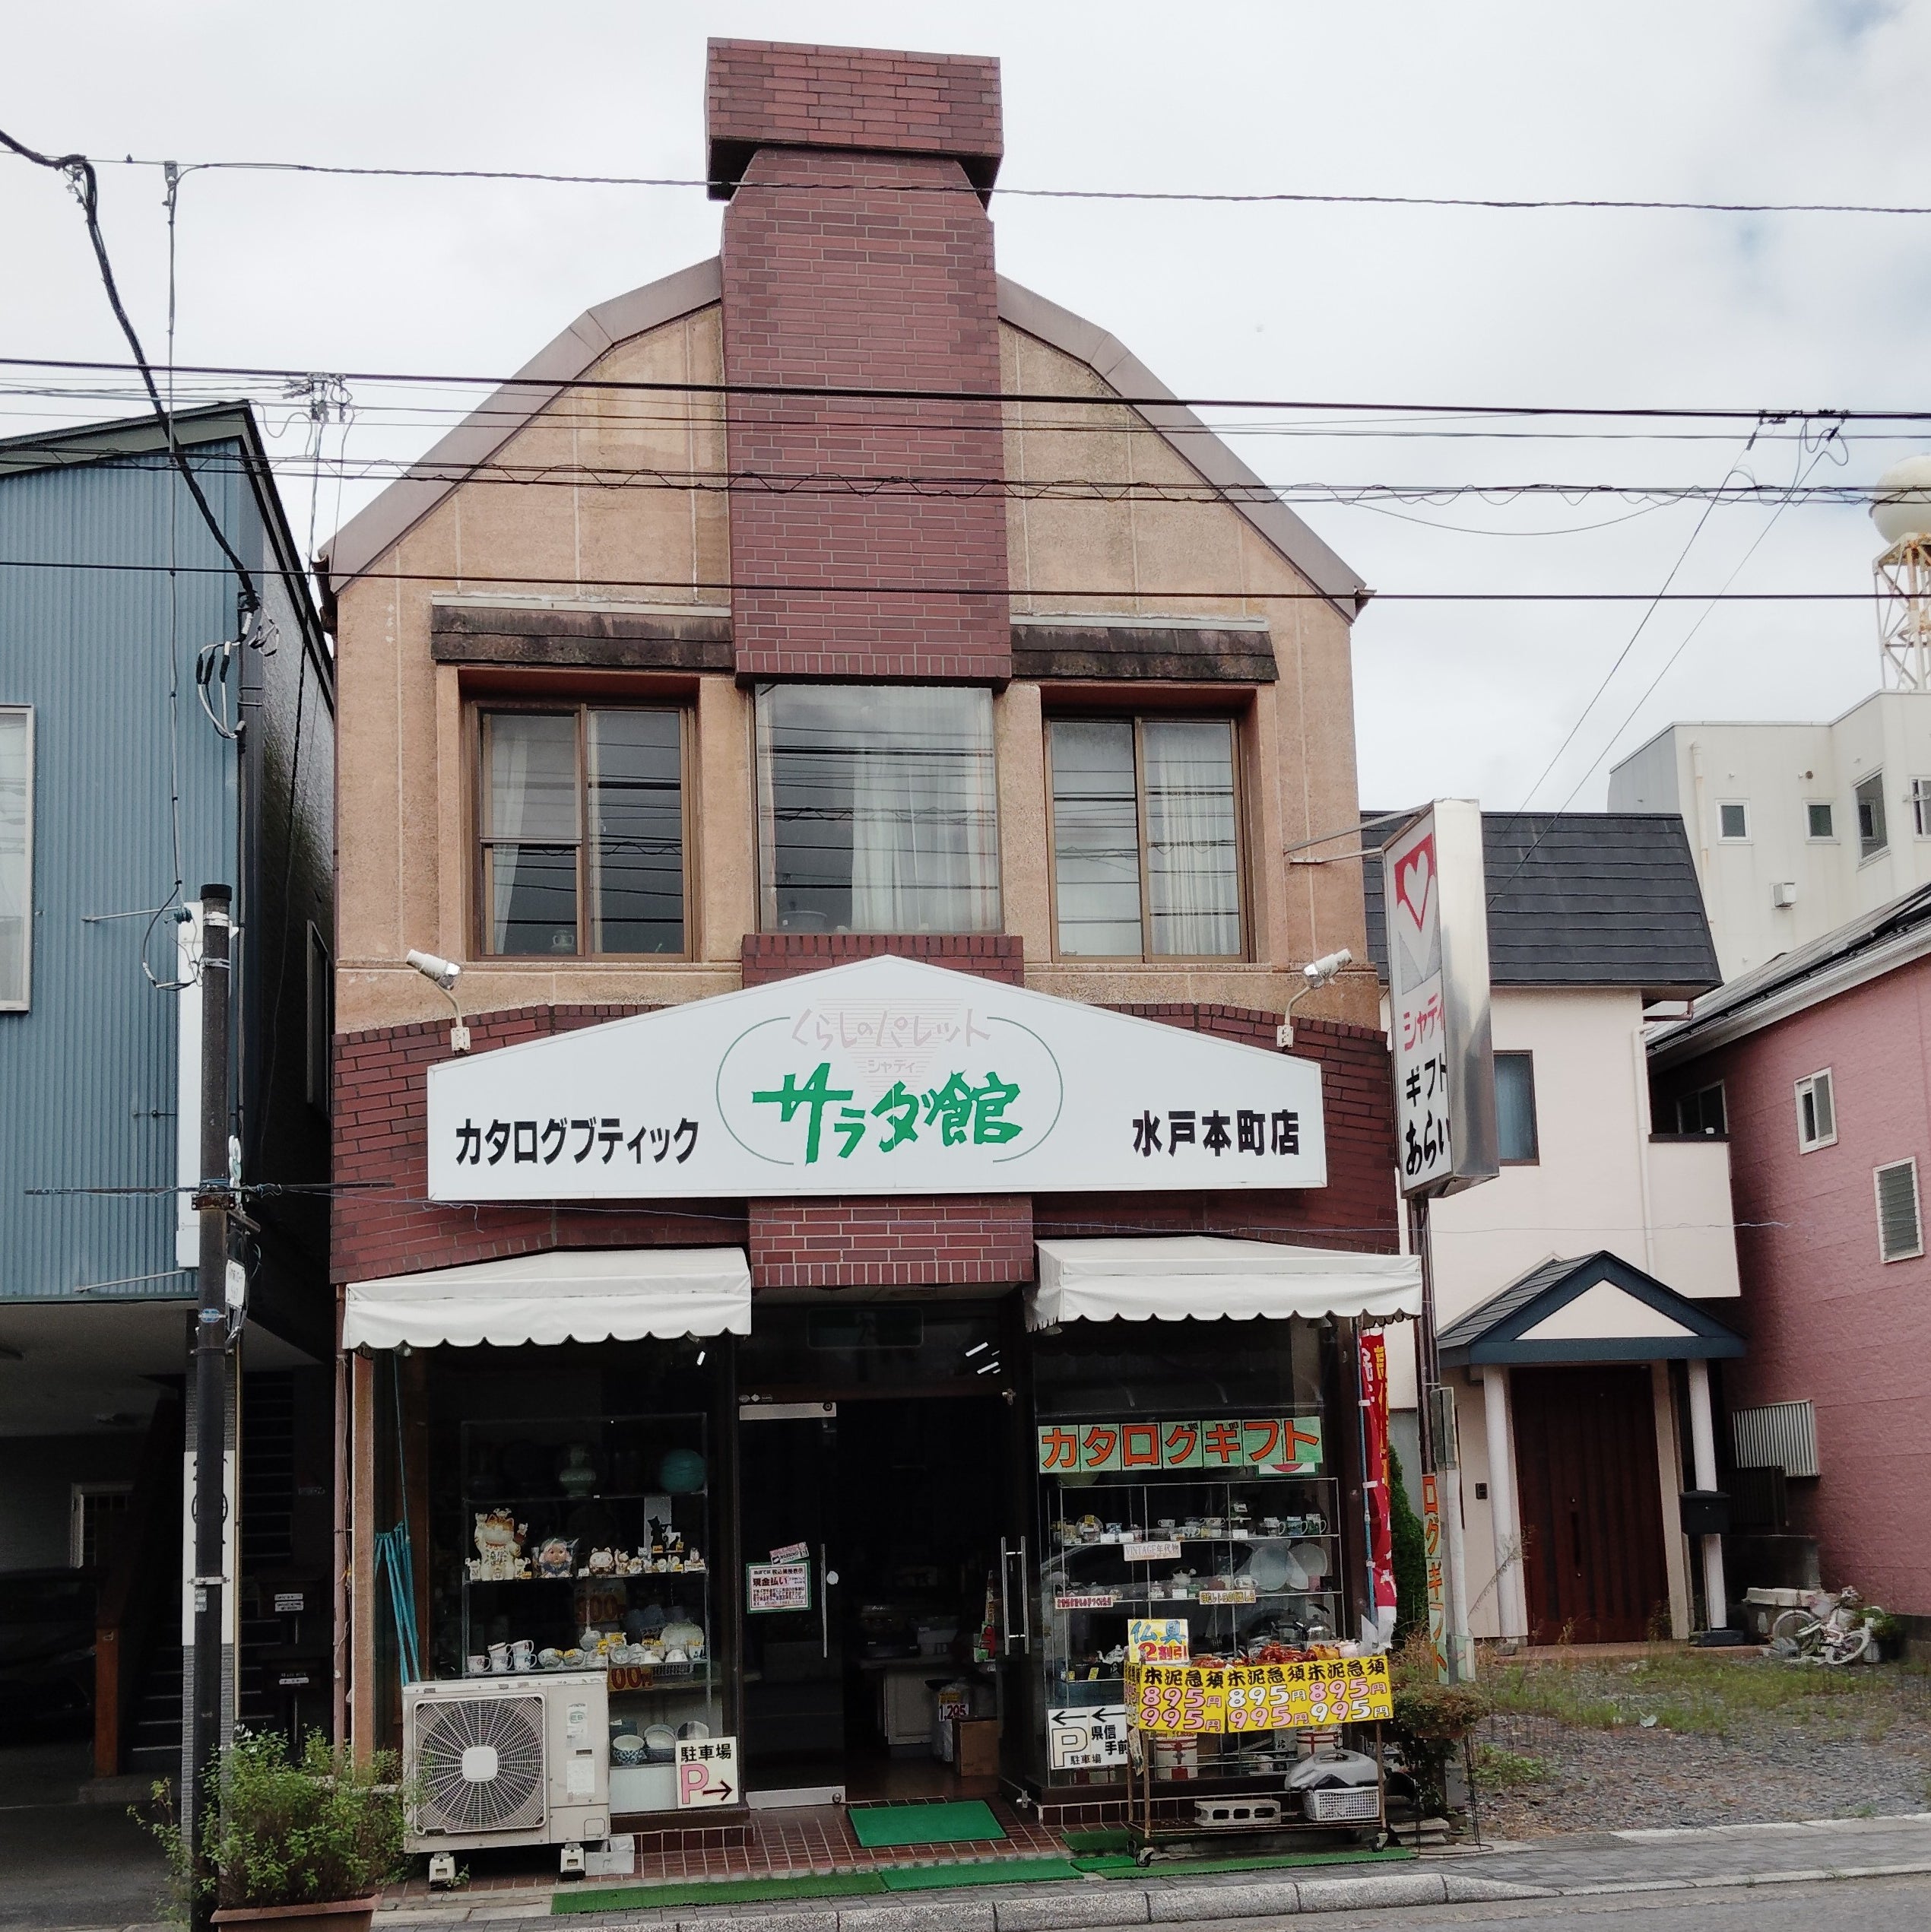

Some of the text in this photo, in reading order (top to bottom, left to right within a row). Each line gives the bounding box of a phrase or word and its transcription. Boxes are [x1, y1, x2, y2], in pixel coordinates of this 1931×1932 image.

[791, 1008, 991, 1052] くらしのパレット
[867, 1058, 917, 1074] シャディ
[1406, 1052, 1447, 1108] ギフト
[752, 1063, 1024, 1166] サラダ館
[455, 1115, 699, 1166] カタログブティック
[1131, 1108, 1301, 1157] 水戸本町店
[1405, 1109, 1451, 1175] あらい
[1041, 1420, 1320, 1470] カタログギフト
[1130, 1620, 1187, 1645] 仏具
[1138, 1642, 1187, 1661] 2割引
[1141, 1686, 1223, 1708] 895円
[1227, 1683, 1307, 1708] 895円
[1308, 1677, 1387, 1702] 895円
[1140, 1706, 1222, 1732] 995円
[1229, 1705, 1309, 1730] 995円
[1310, 1698, 1390, 1723] 995円
[1091, 1724, 1117, 1740] 県信
[680, 1743, 732, 1763] 駐車場
[1051, 1726, 1088, 1769] P
[1070, 1753, 1102, 1765] 駐車場
[1105, 1739, 1127, 1756] 手前
[680, 1763, 709, 1804] P
